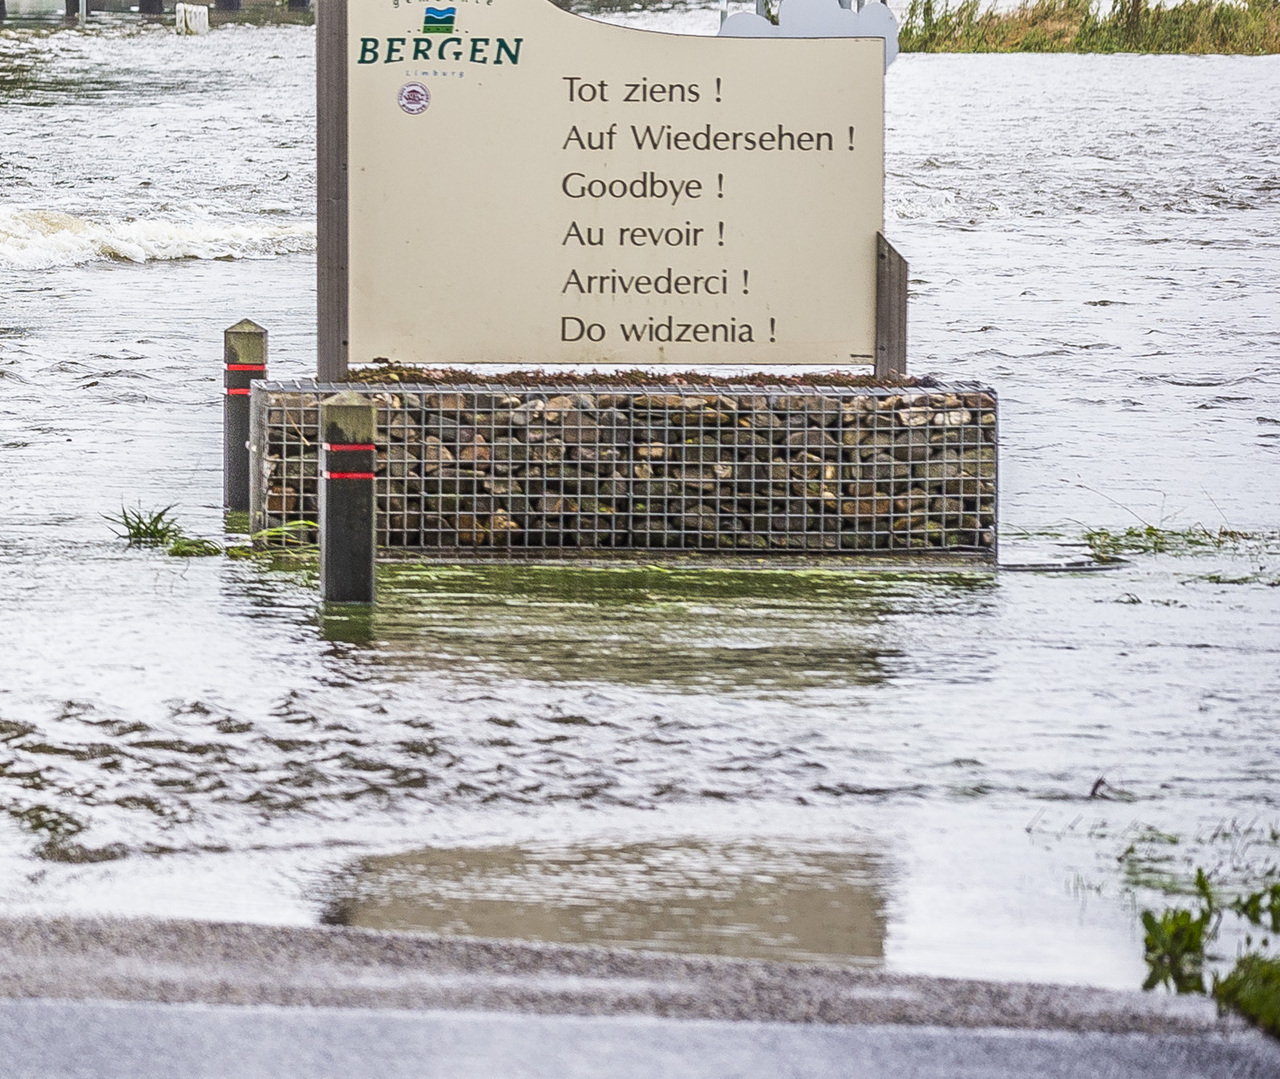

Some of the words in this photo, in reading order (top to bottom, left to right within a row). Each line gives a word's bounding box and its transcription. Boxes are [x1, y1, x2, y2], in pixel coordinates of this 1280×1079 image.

[357, 37, 524, 65] BERGEN
[562, 77, 609, 103] Tot
[622, 77, 701, 103] ziens
[562, 123, 617, 151] Auf
[630, 124, 834, 152] Wiedersehen
[561, 172, 703, 207] Goodbye
[562, 220, 604, 247] Au
[619, 220, 705, 247] revoir
[562, 268, 728, 295] Arrivederci
[560, 316, 606, 343] Do
[619, 315, 756, 343] widzenia
